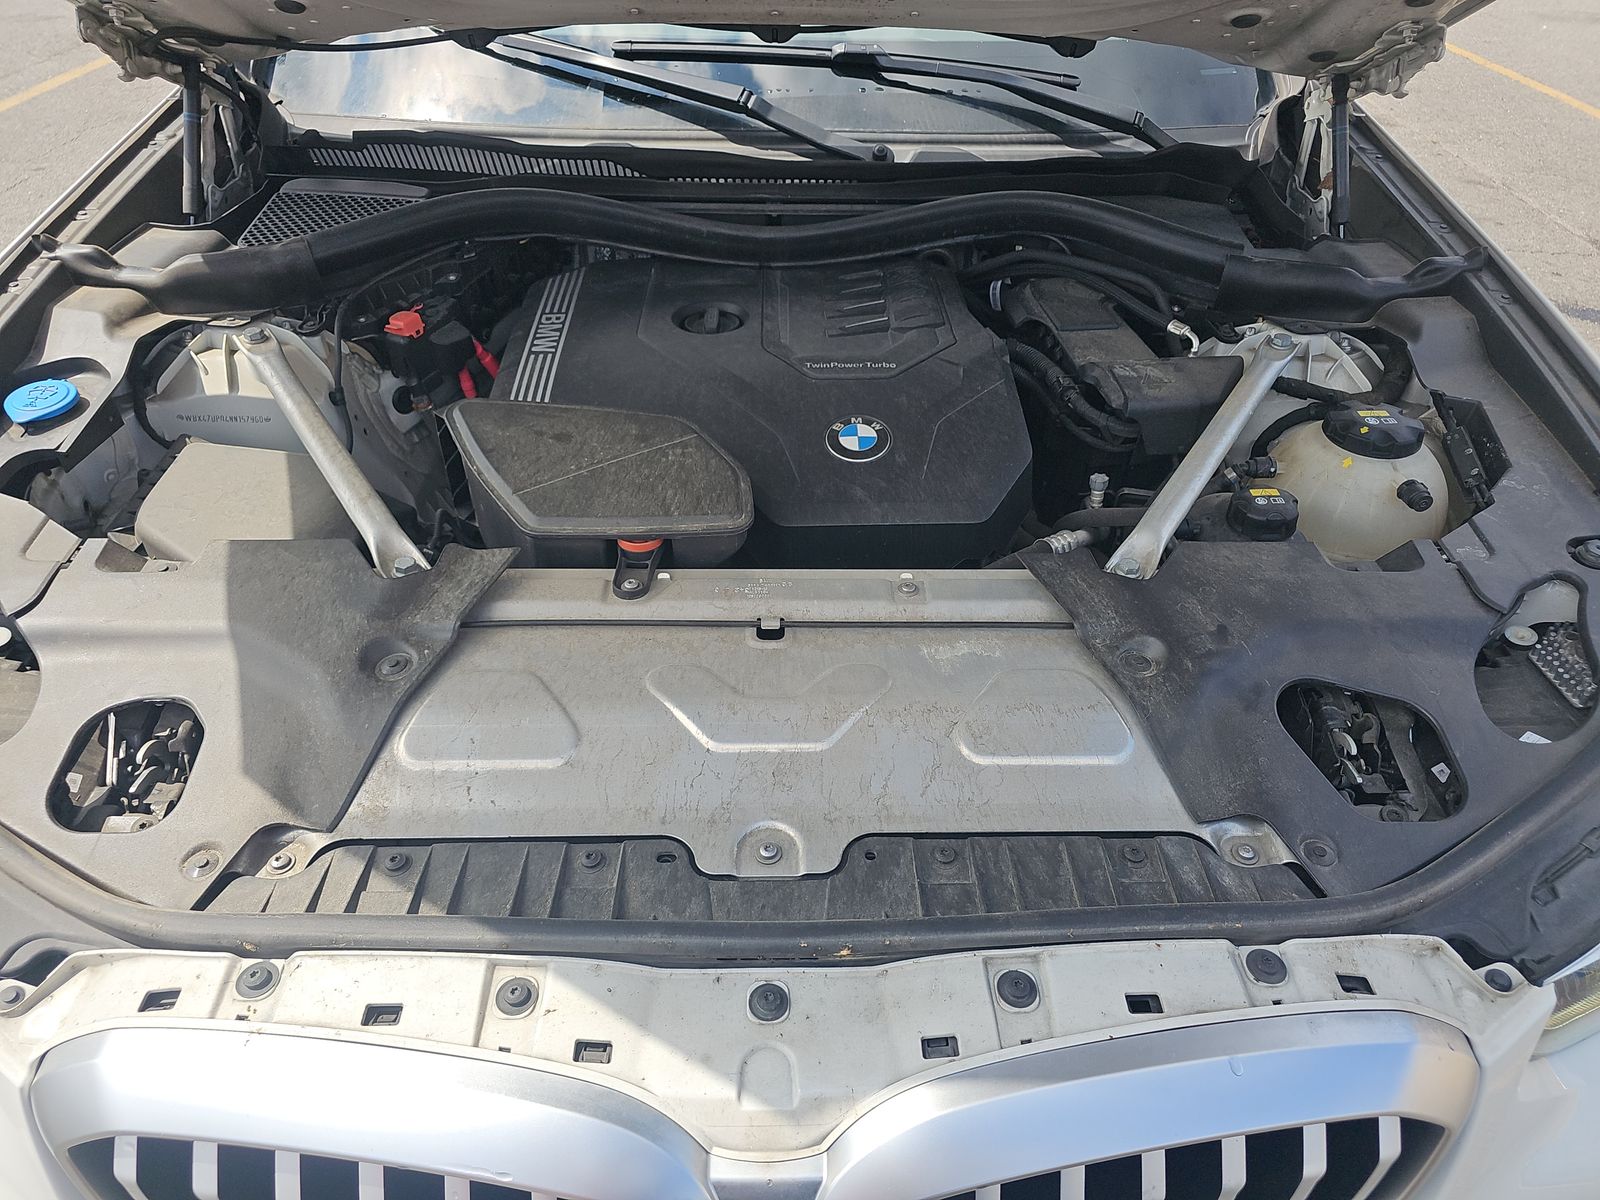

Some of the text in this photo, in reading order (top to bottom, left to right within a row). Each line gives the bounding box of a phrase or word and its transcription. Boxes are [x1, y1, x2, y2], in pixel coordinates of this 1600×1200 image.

[530, 313, 566, 352] BMW
[805, 361, 897, 369] TwinPower Turbo
